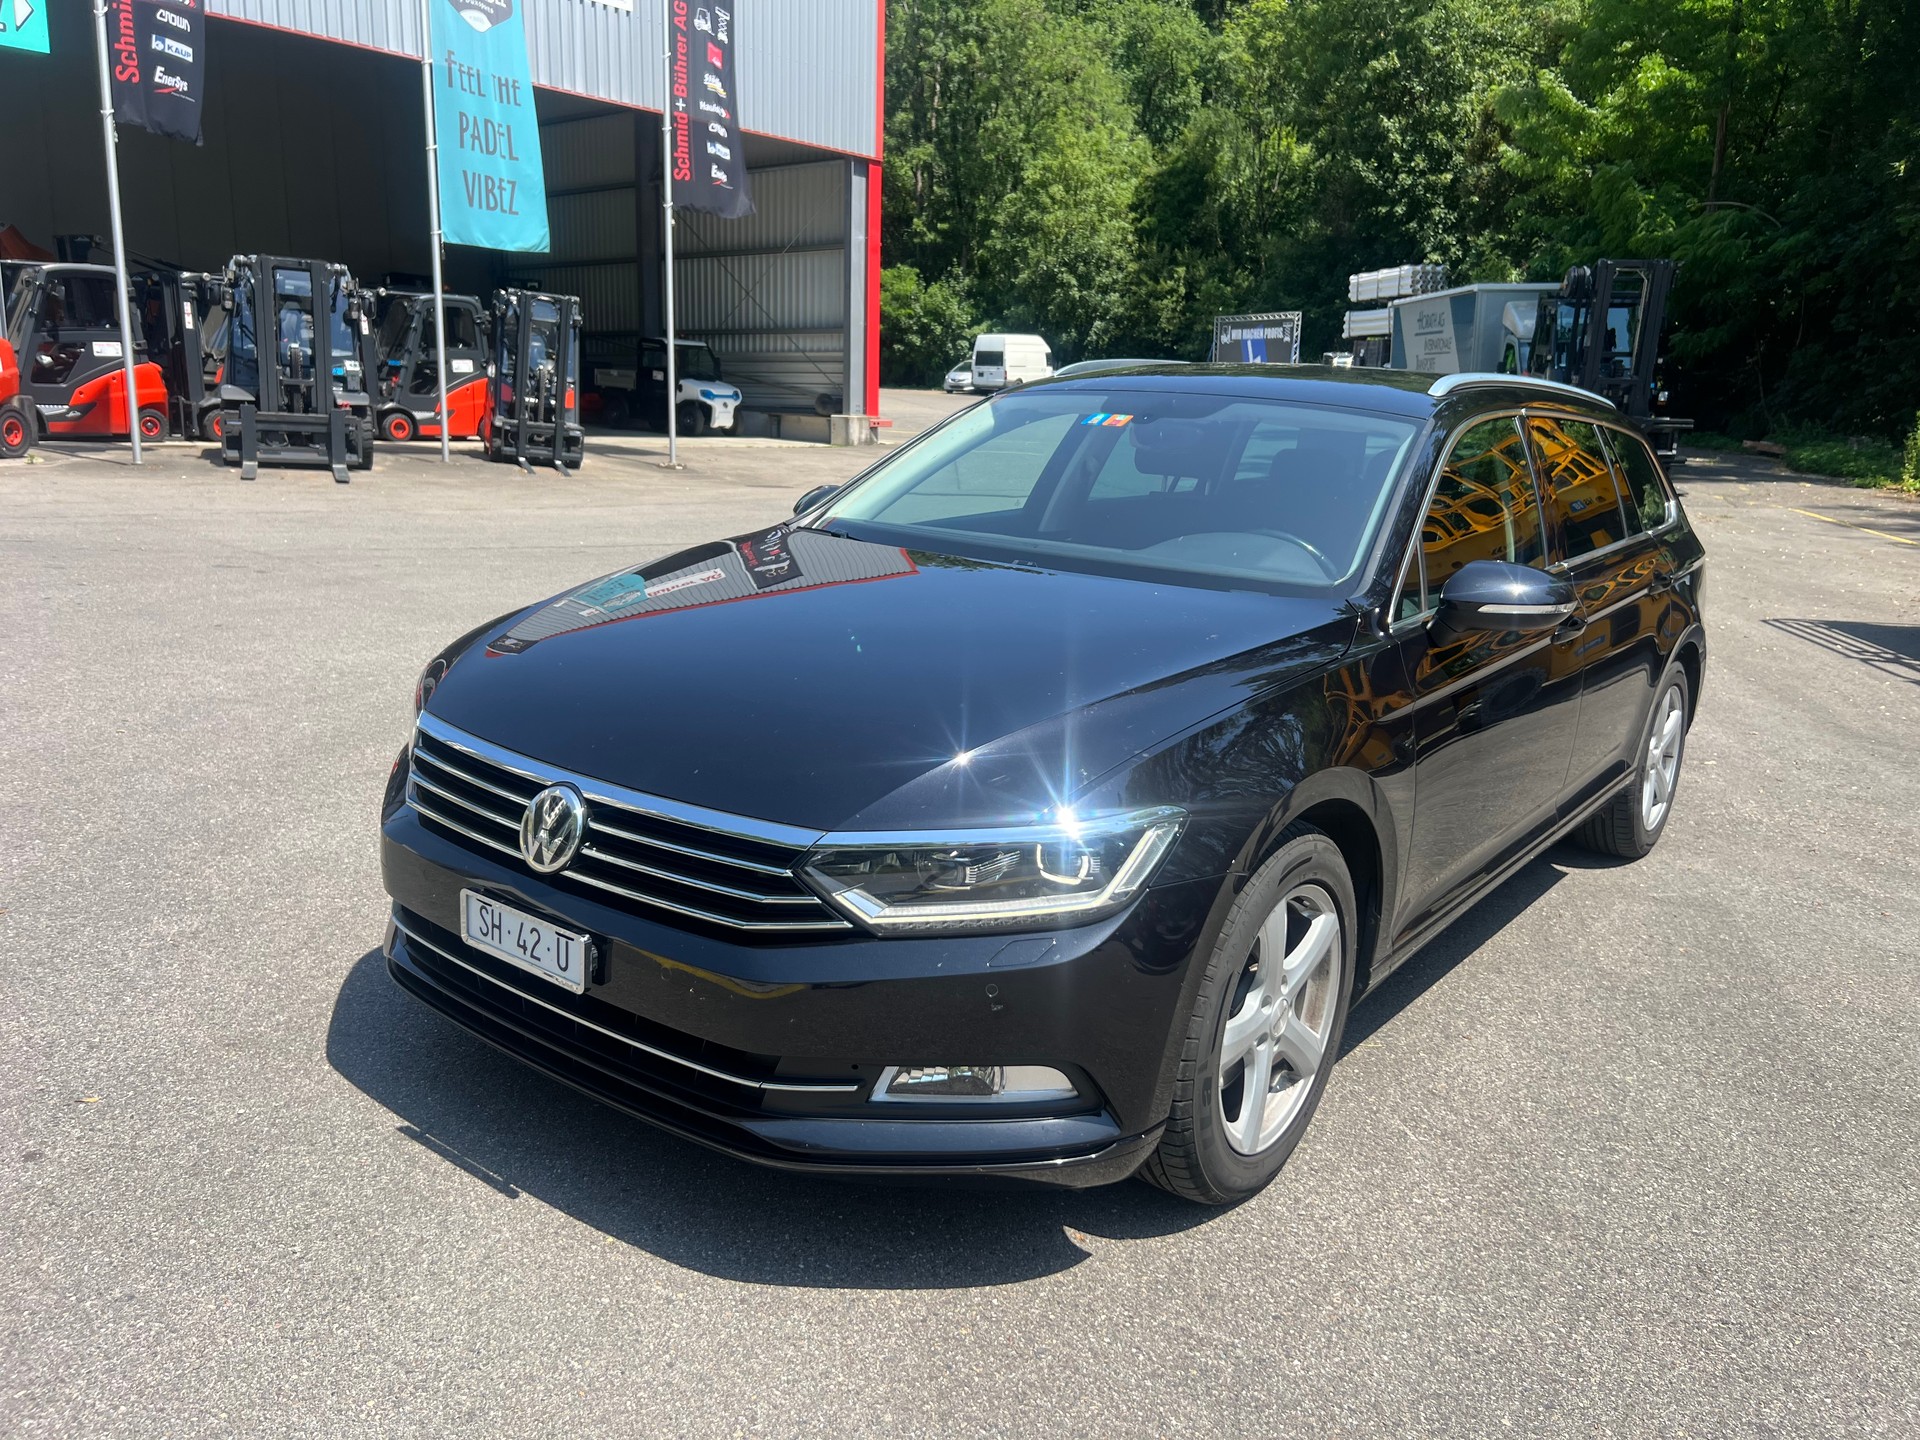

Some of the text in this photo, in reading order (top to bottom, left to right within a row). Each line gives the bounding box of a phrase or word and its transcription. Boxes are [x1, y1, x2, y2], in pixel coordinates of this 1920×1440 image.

[673, 0, 688, 32] AG
[112, 0, 140, 83] Schmi
[167, 43, 192, 58] KAUP
[445, 49, 487, 97] FEEL
[459, 111, 520, 161] PADEL
[462, 169, 519, 215] VIBEZ
